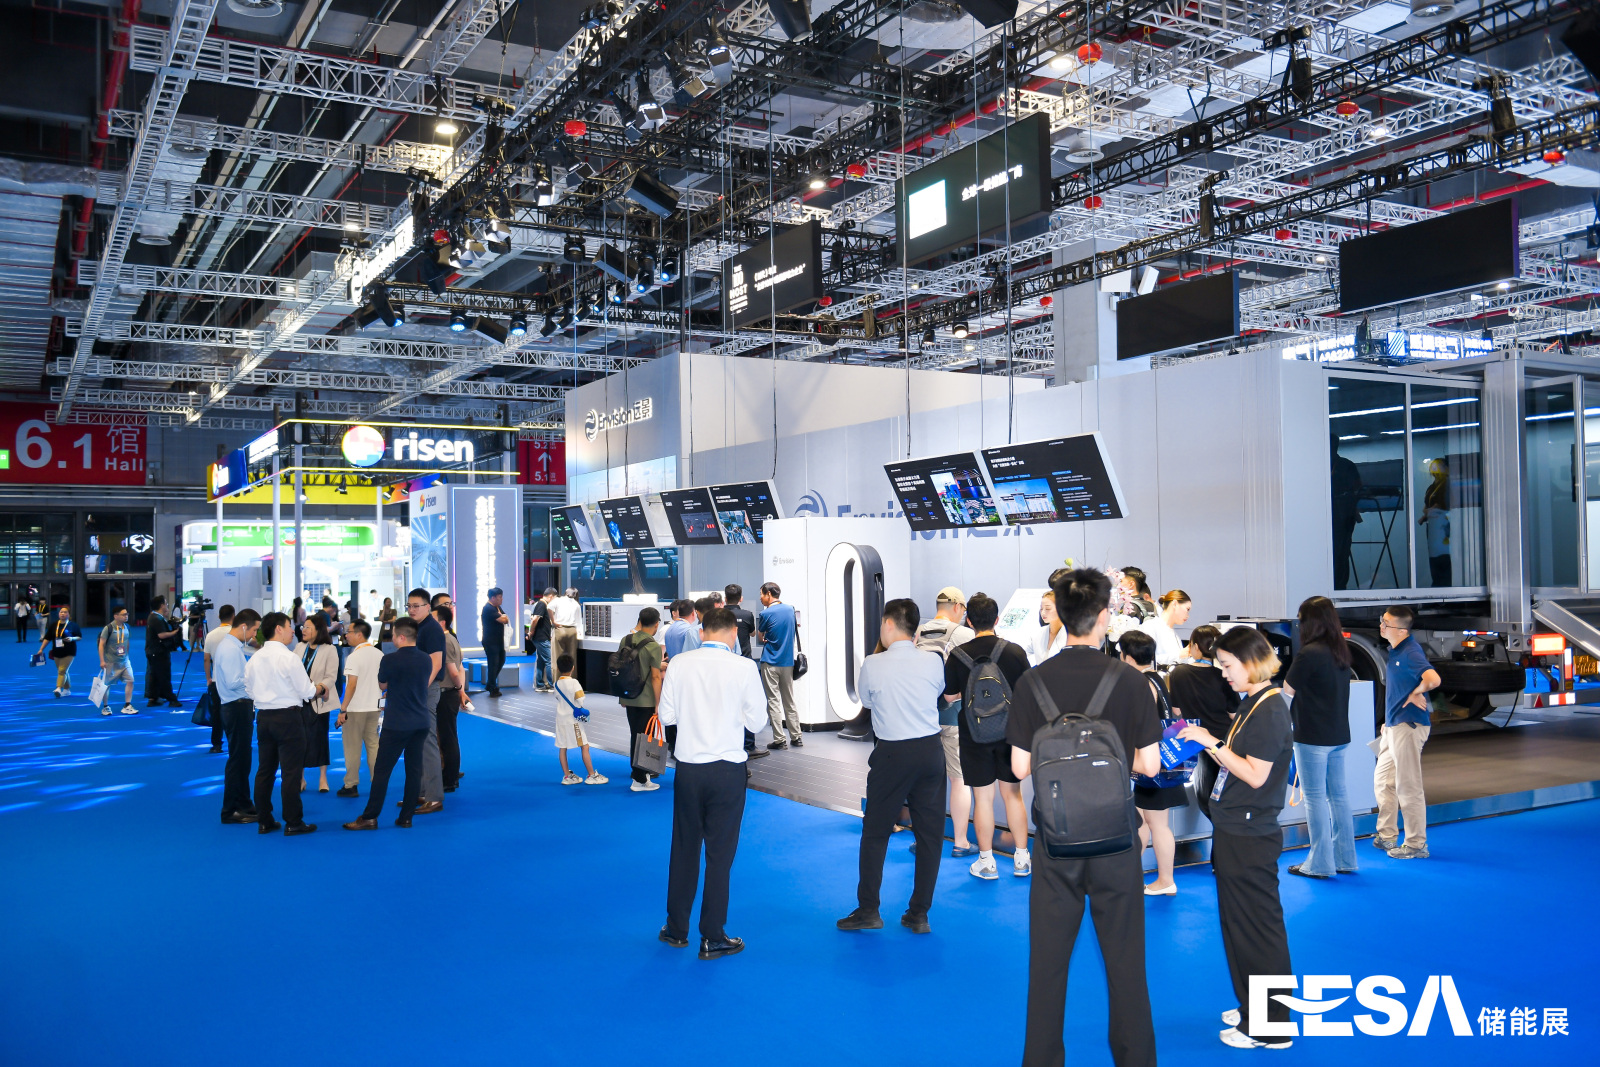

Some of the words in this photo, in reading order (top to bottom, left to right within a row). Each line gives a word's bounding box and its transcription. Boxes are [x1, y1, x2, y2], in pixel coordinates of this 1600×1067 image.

[598, 407, 633, 431] Envision
[633, 397, 652, 421] 远景
[16, 419, 92, 469] 6.1
[107, 425, 140, 454] 馆
[394, 431, 474, 462] risen
[105, 457, 144, 471] Hall
[534, 471, 548, 481] 5.1
[425, 494, 437, 508] risen
